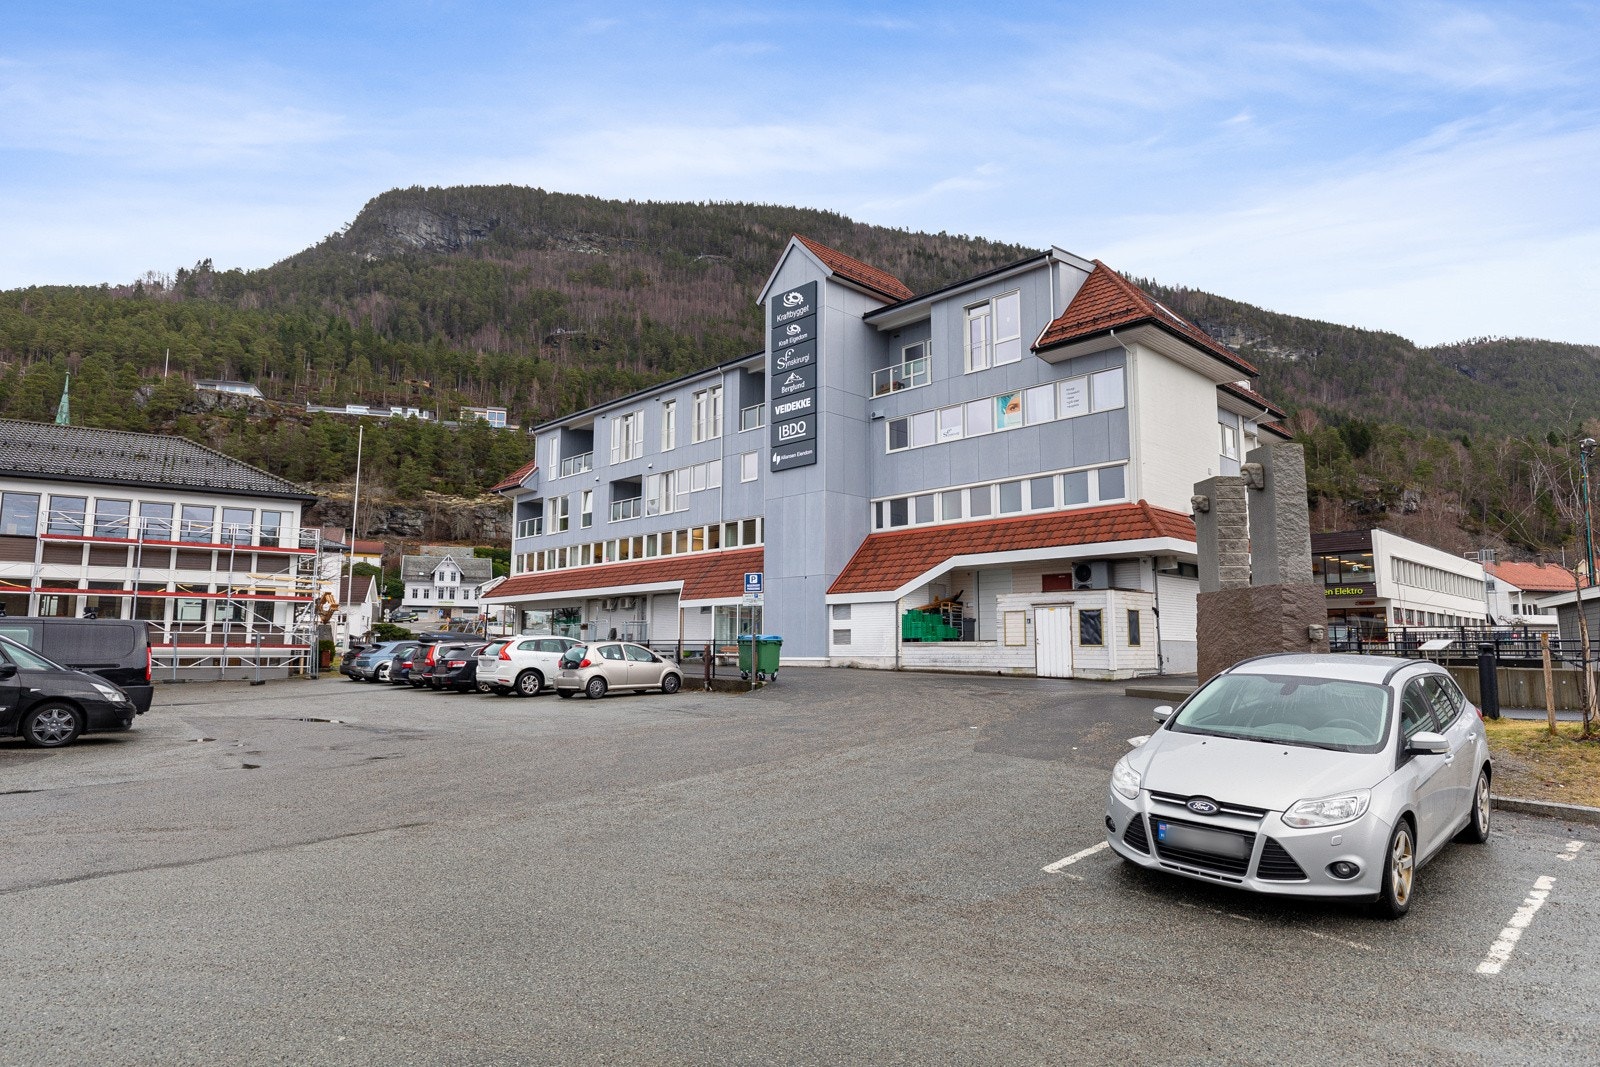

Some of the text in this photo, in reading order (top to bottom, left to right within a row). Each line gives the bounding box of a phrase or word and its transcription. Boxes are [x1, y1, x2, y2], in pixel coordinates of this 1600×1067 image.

[776, 304, 809, 322] Kraftbygget
[778, 338, 789, 347] Kraft
[781, 380, 806, 394] Berglund
[775, 397, 811, 415] VEIDEKKE
[782, 420, 807, 437] BDO
[1335, 587, 1363, 595] Elektro
[1193, 802, 1211, 811] Ford
